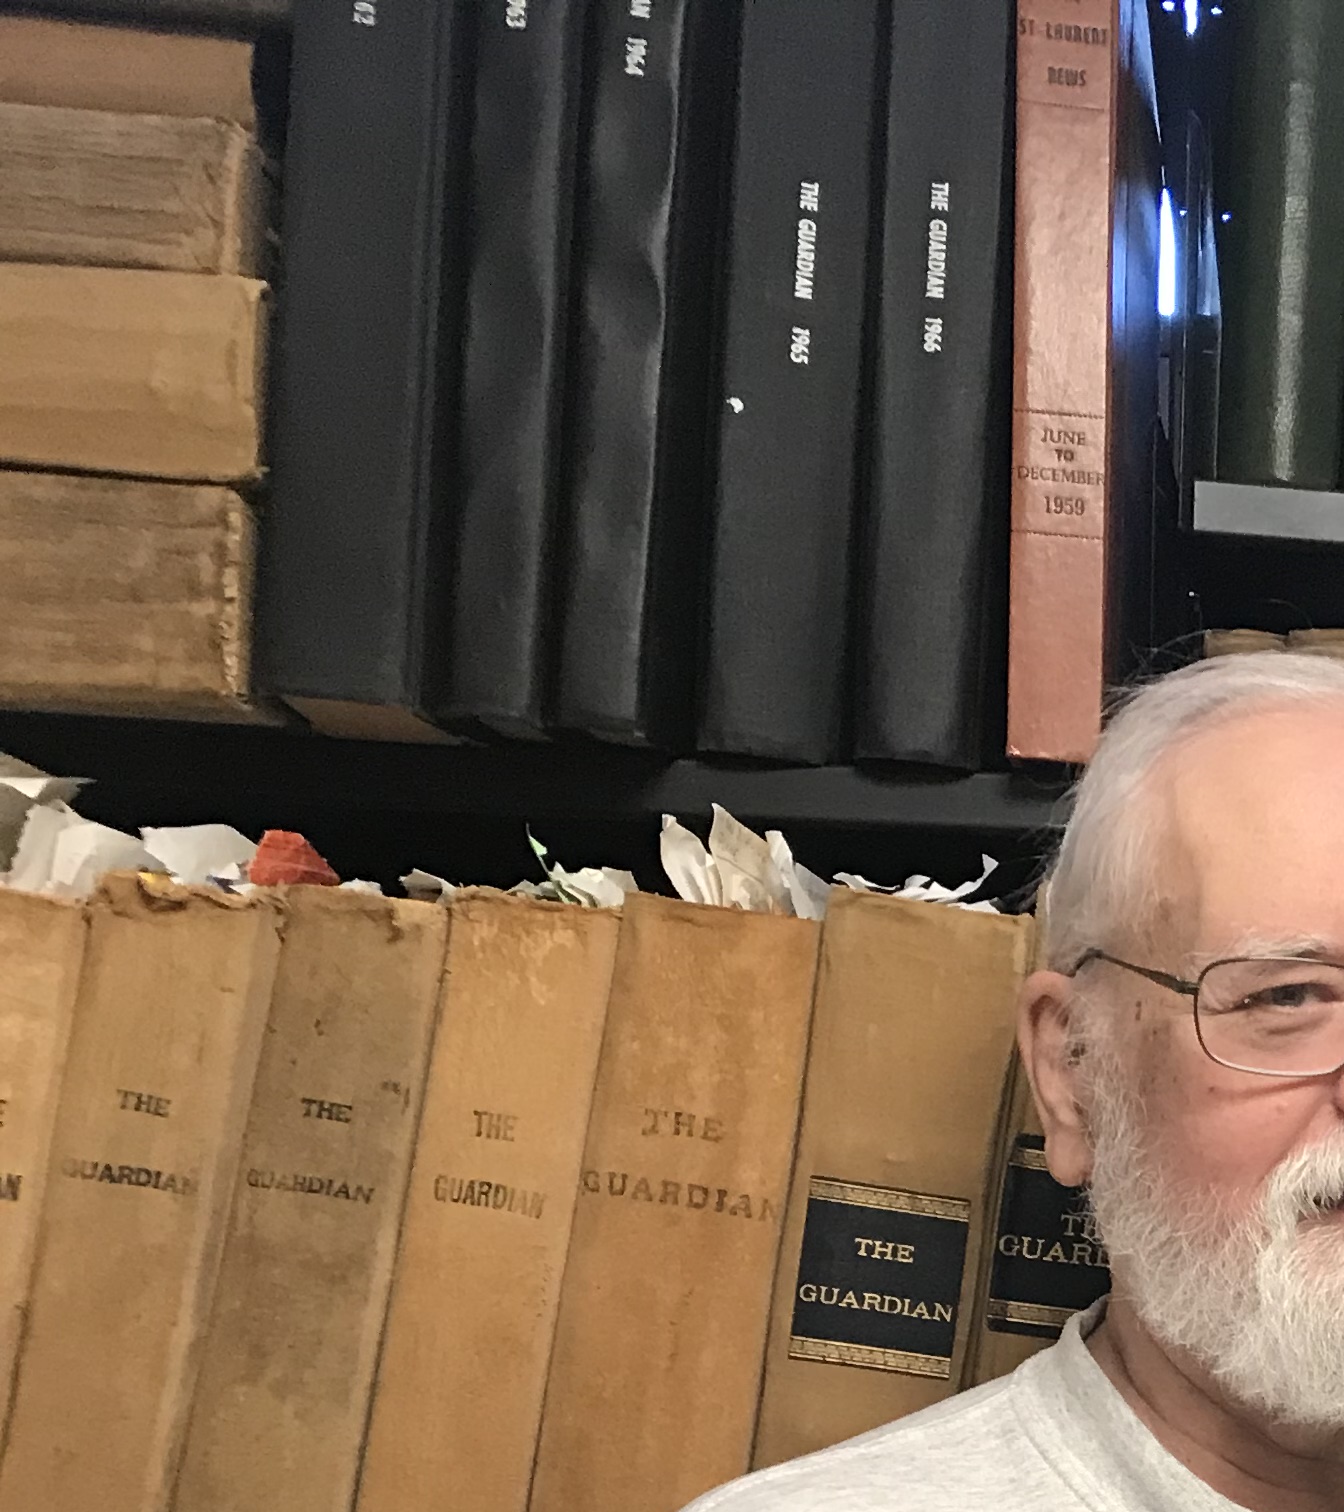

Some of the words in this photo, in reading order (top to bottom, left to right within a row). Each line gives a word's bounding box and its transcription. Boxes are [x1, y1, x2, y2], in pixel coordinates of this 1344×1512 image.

[1046, 22, 1108, 46] LAURENT
[1047, 66, 1087, 87] NEWS
[799, 181, 820, 212] THE
[930, 181, 950, 212] THE
[793, 218, 819, 300] GUARDIAN
[925, 218, 949, 299] GUARDIAN
[789, 326, 811, 366] 1965
[922, 316, 944, 354] 1966
[1040, 428, 1087, 448] JUNE
[1054, 449, 1075, 464] TO
[1016, 466, 1105, 488] DECEMBER
[1043, 495, 1086, 518] 1959
[116, 1089, 172, 1119] THE
[300, 1097, 353, 1125] THE
[472, 1110, 519, 1143] THE
[640, 1106, 727, 1144] THE
[61, 1157, 200, 1196] GUARDIAN
[246, 1167, 376, 1206] GUARDIAN
[433, 1174, 548, 1221] GUARDIAN
[579, 1169, 780, 1224] GUARDIAN
[854, 1236, 915, 1265] THE
[798, 1283, 954, 1323] GUARDIAN
